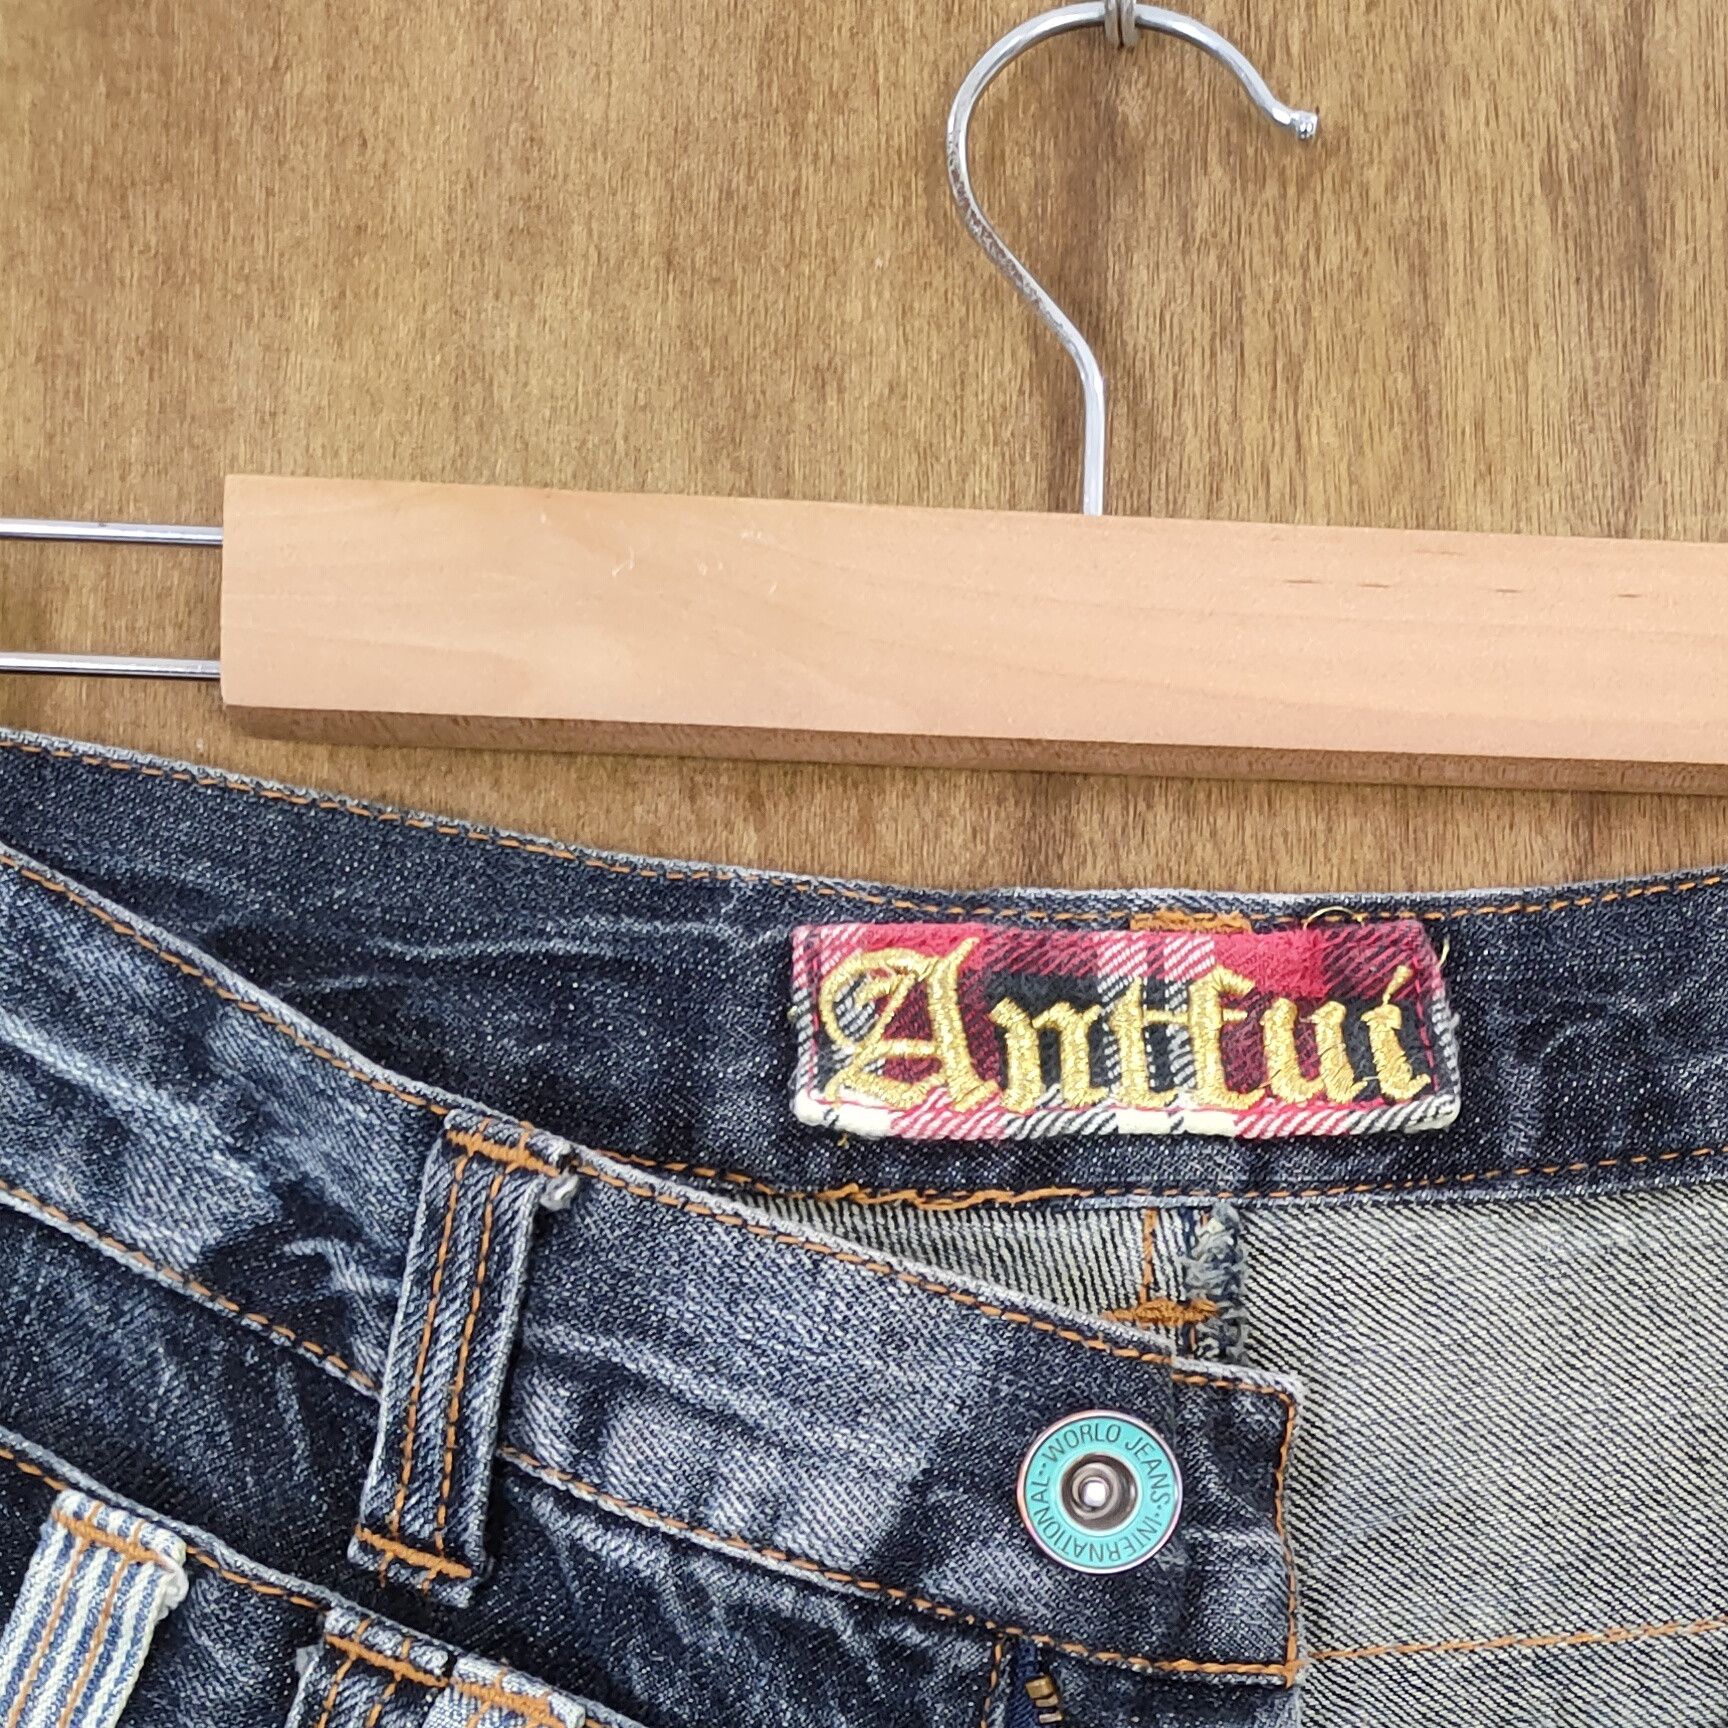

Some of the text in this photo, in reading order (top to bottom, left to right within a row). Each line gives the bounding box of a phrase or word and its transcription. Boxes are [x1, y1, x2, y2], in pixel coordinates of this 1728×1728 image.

[1031, 1423, 1171, 1562] WORLD JEANS INTERNATIONAL
